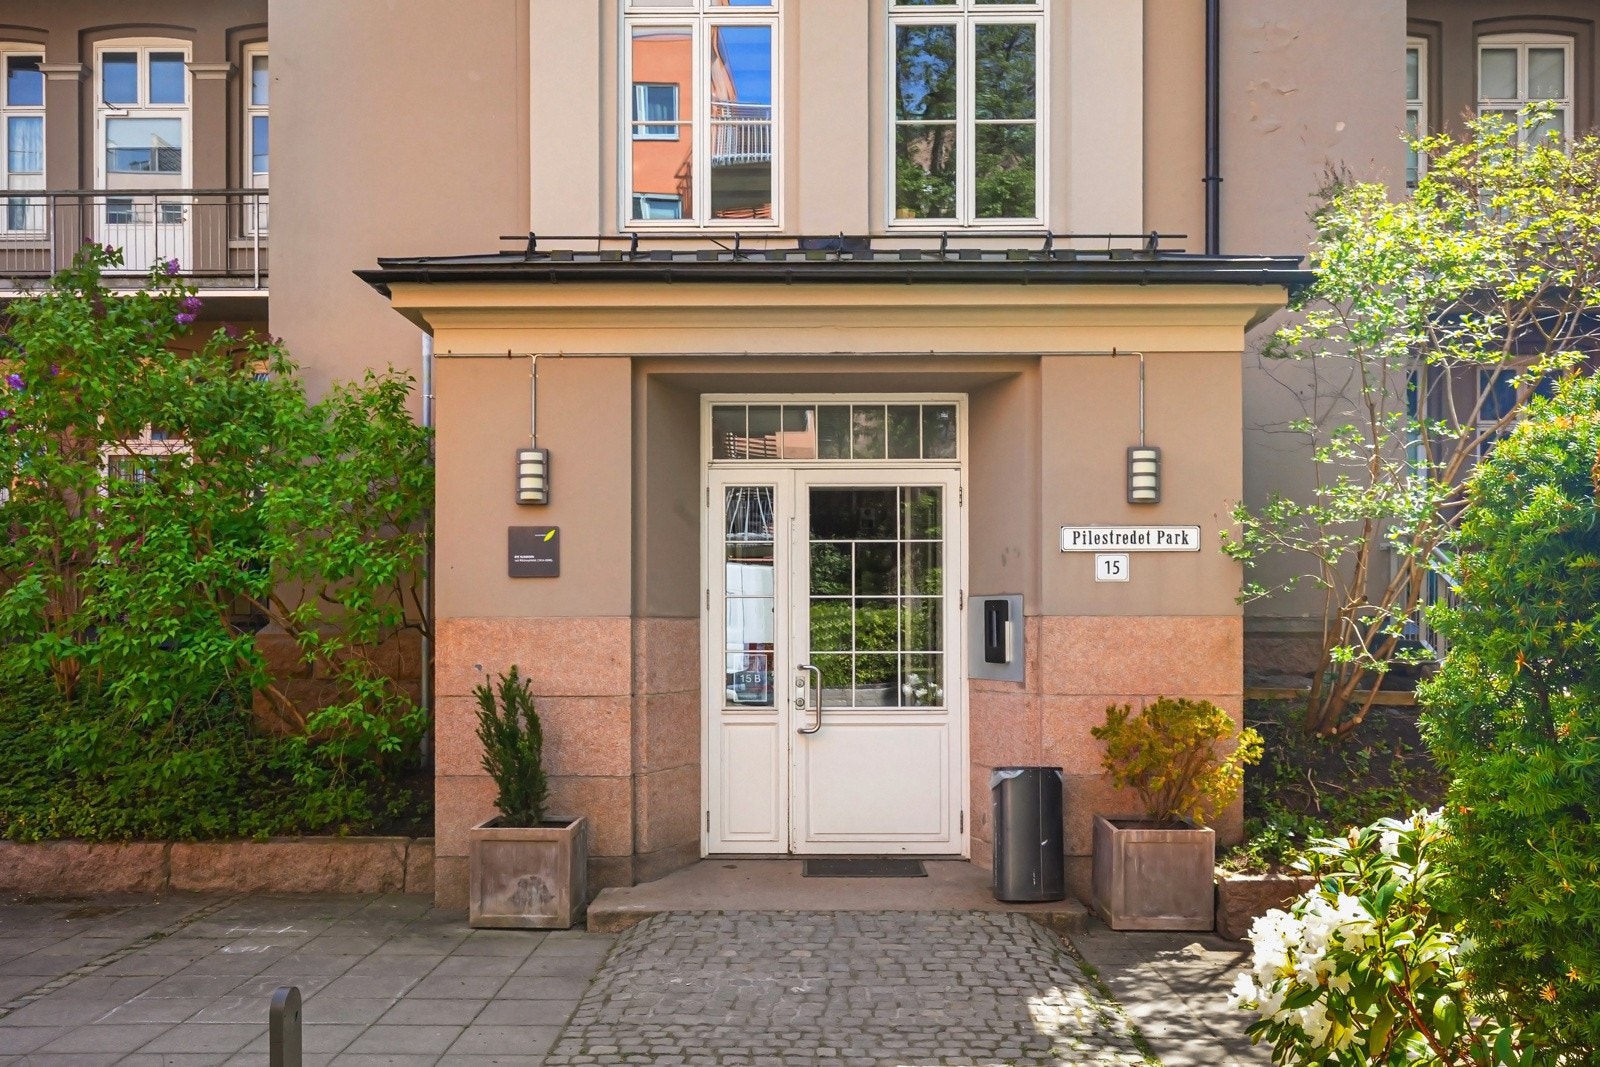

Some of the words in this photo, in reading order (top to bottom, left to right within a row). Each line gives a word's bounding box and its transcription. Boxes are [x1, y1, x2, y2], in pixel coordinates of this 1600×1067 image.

[1072, 530, 1151, 545] Pilestredet
[1157, 530, 1190, 545] Park
[1104, 560, 1121, 575] 15
[740, 674, 752, 683] 15
[754, 674, 761, 683] B
